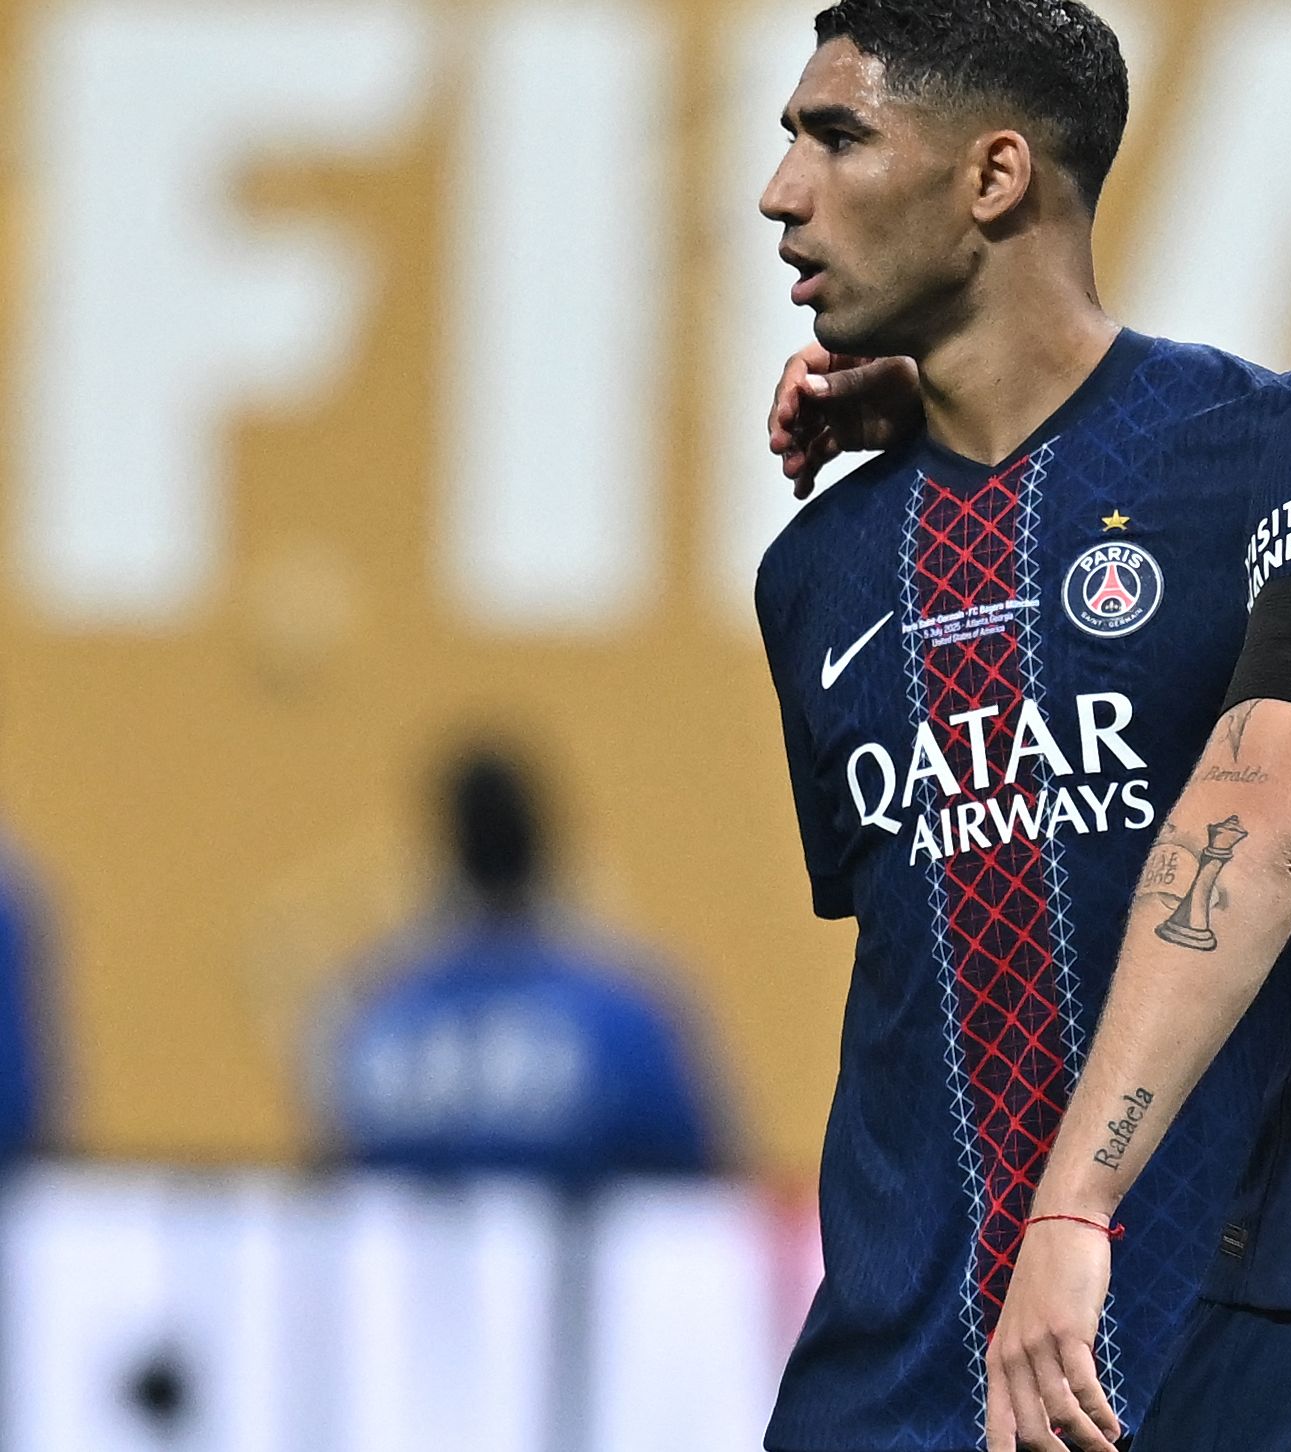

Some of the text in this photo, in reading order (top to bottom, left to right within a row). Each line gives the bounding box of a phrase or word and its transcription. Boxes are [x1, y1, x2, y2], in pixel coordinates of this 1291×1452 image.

[1080, 547, 1144, 572] PARIS
[847, 692, 1148, 835] QATAR
[1203, 765, 1269, 784] Beraldo
[909, 780, 1155, 866] AIRWAYS
[1093, 1087, 1154, 1171] Rafaela
